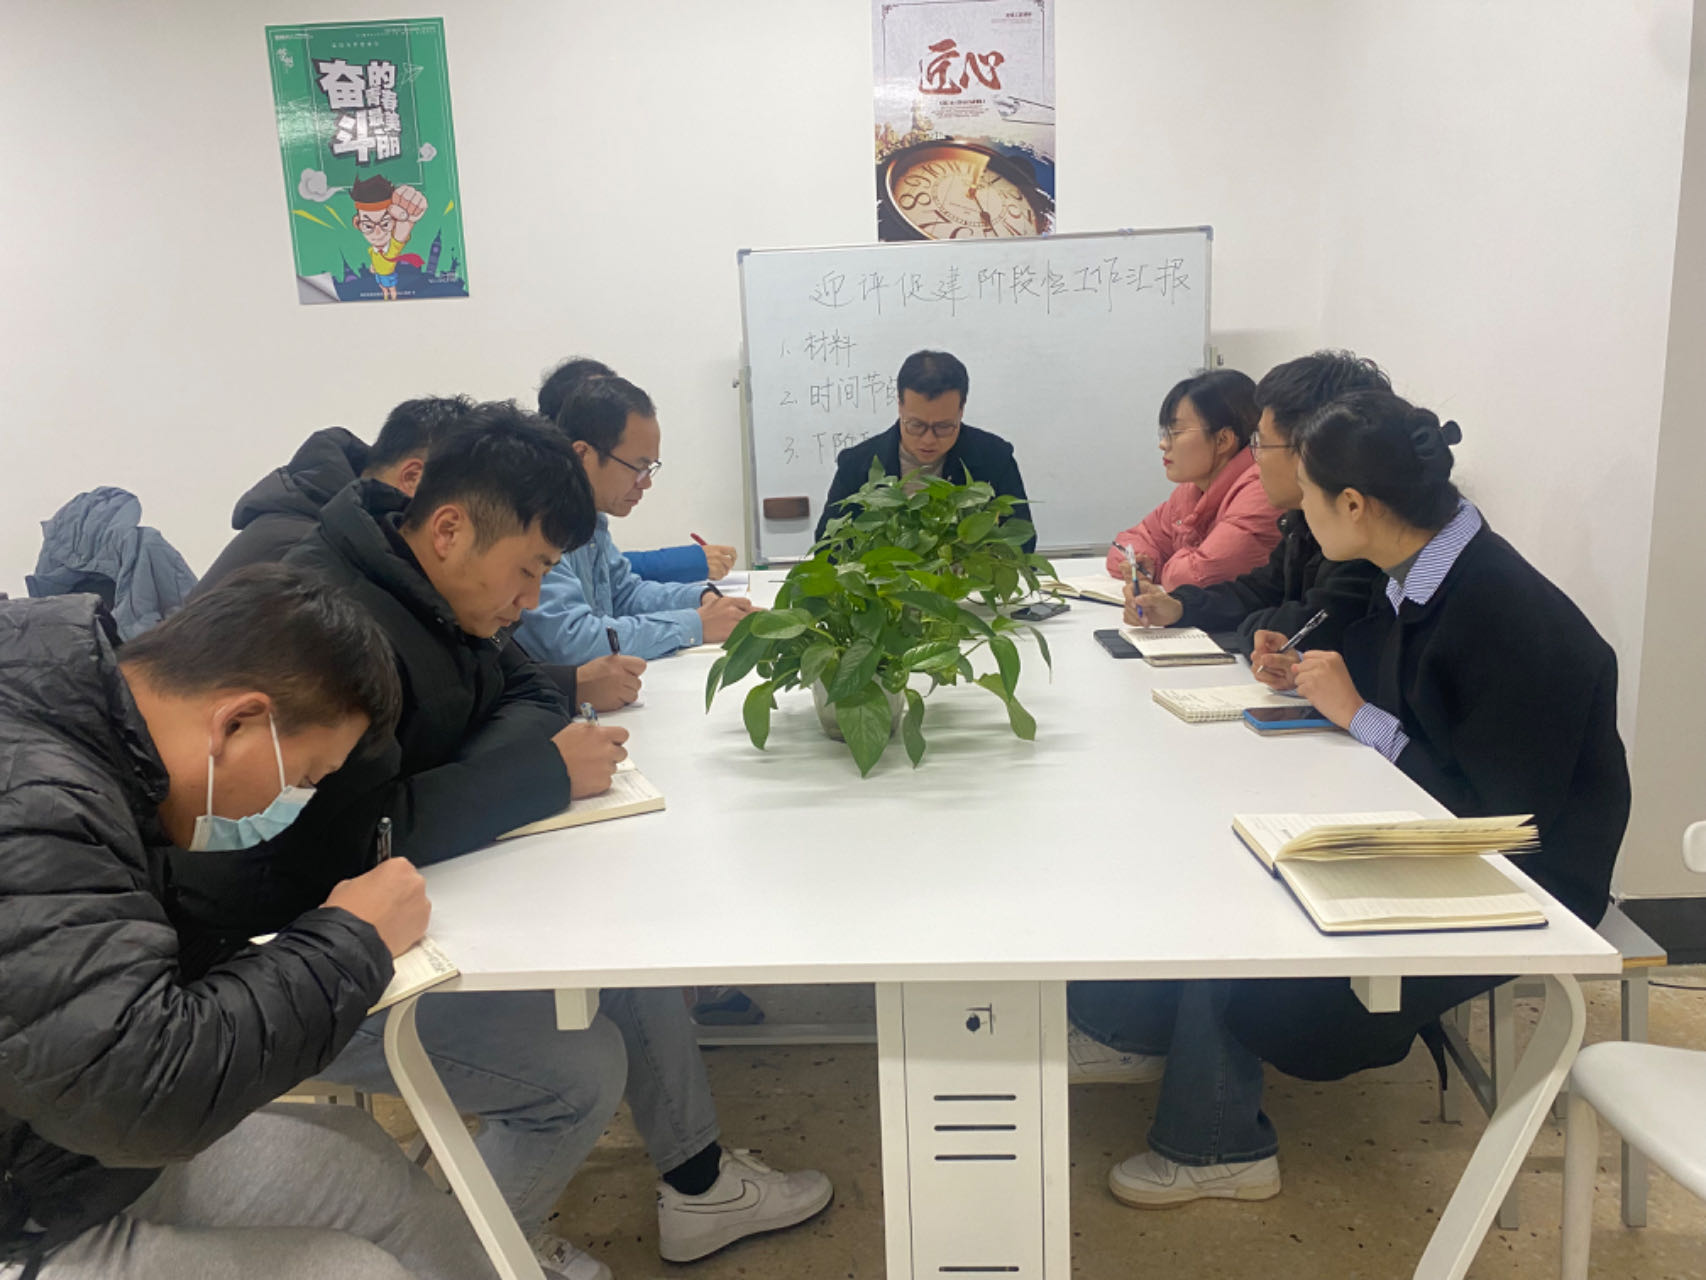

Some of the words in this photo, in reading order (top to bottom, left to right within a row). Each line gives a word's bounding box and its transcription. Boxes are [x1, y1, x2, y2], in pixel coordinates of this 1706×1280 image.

[918, 38, 1005, 95] 匠心
[899, 191, 931, 211] 8
[804, 328, 857, 368] 材料
